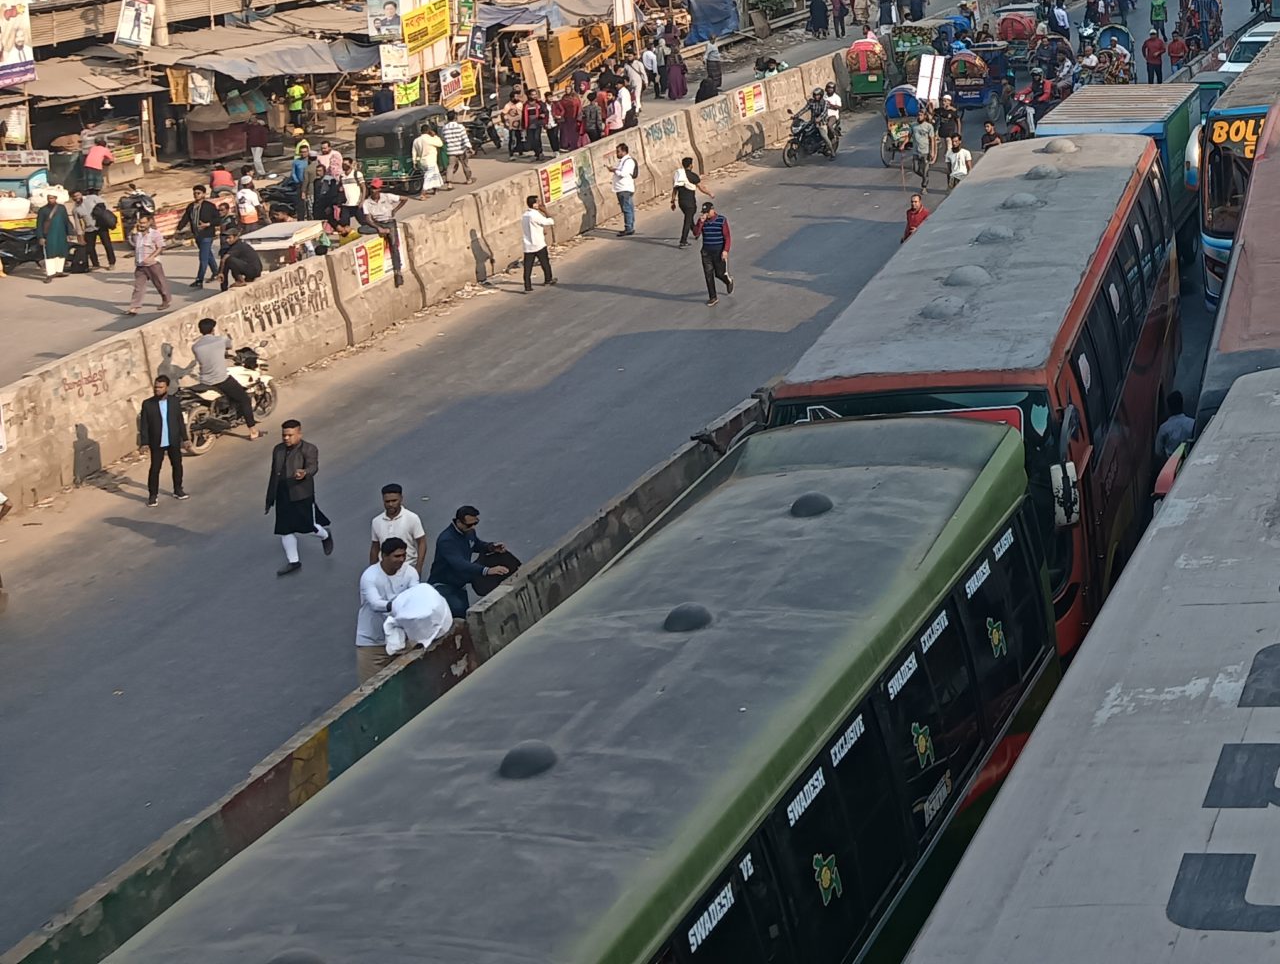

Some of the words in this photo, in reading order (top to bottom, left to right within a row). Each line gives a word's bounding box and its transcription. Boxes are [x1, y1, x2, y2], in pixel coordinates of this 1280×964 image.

[1213, 118, 1264, 144] BOL
[965, 559, 991, 599] SWADESH
[920, 610, 948, 654] EXCLUSIVE
[888, 652, 918, 701] SWADESH
[830, 714, 866, 767] EXCLUSIVE
[787, 767, 826, 827] SWADESH
[688, 882, 734, 953] SWADESH
